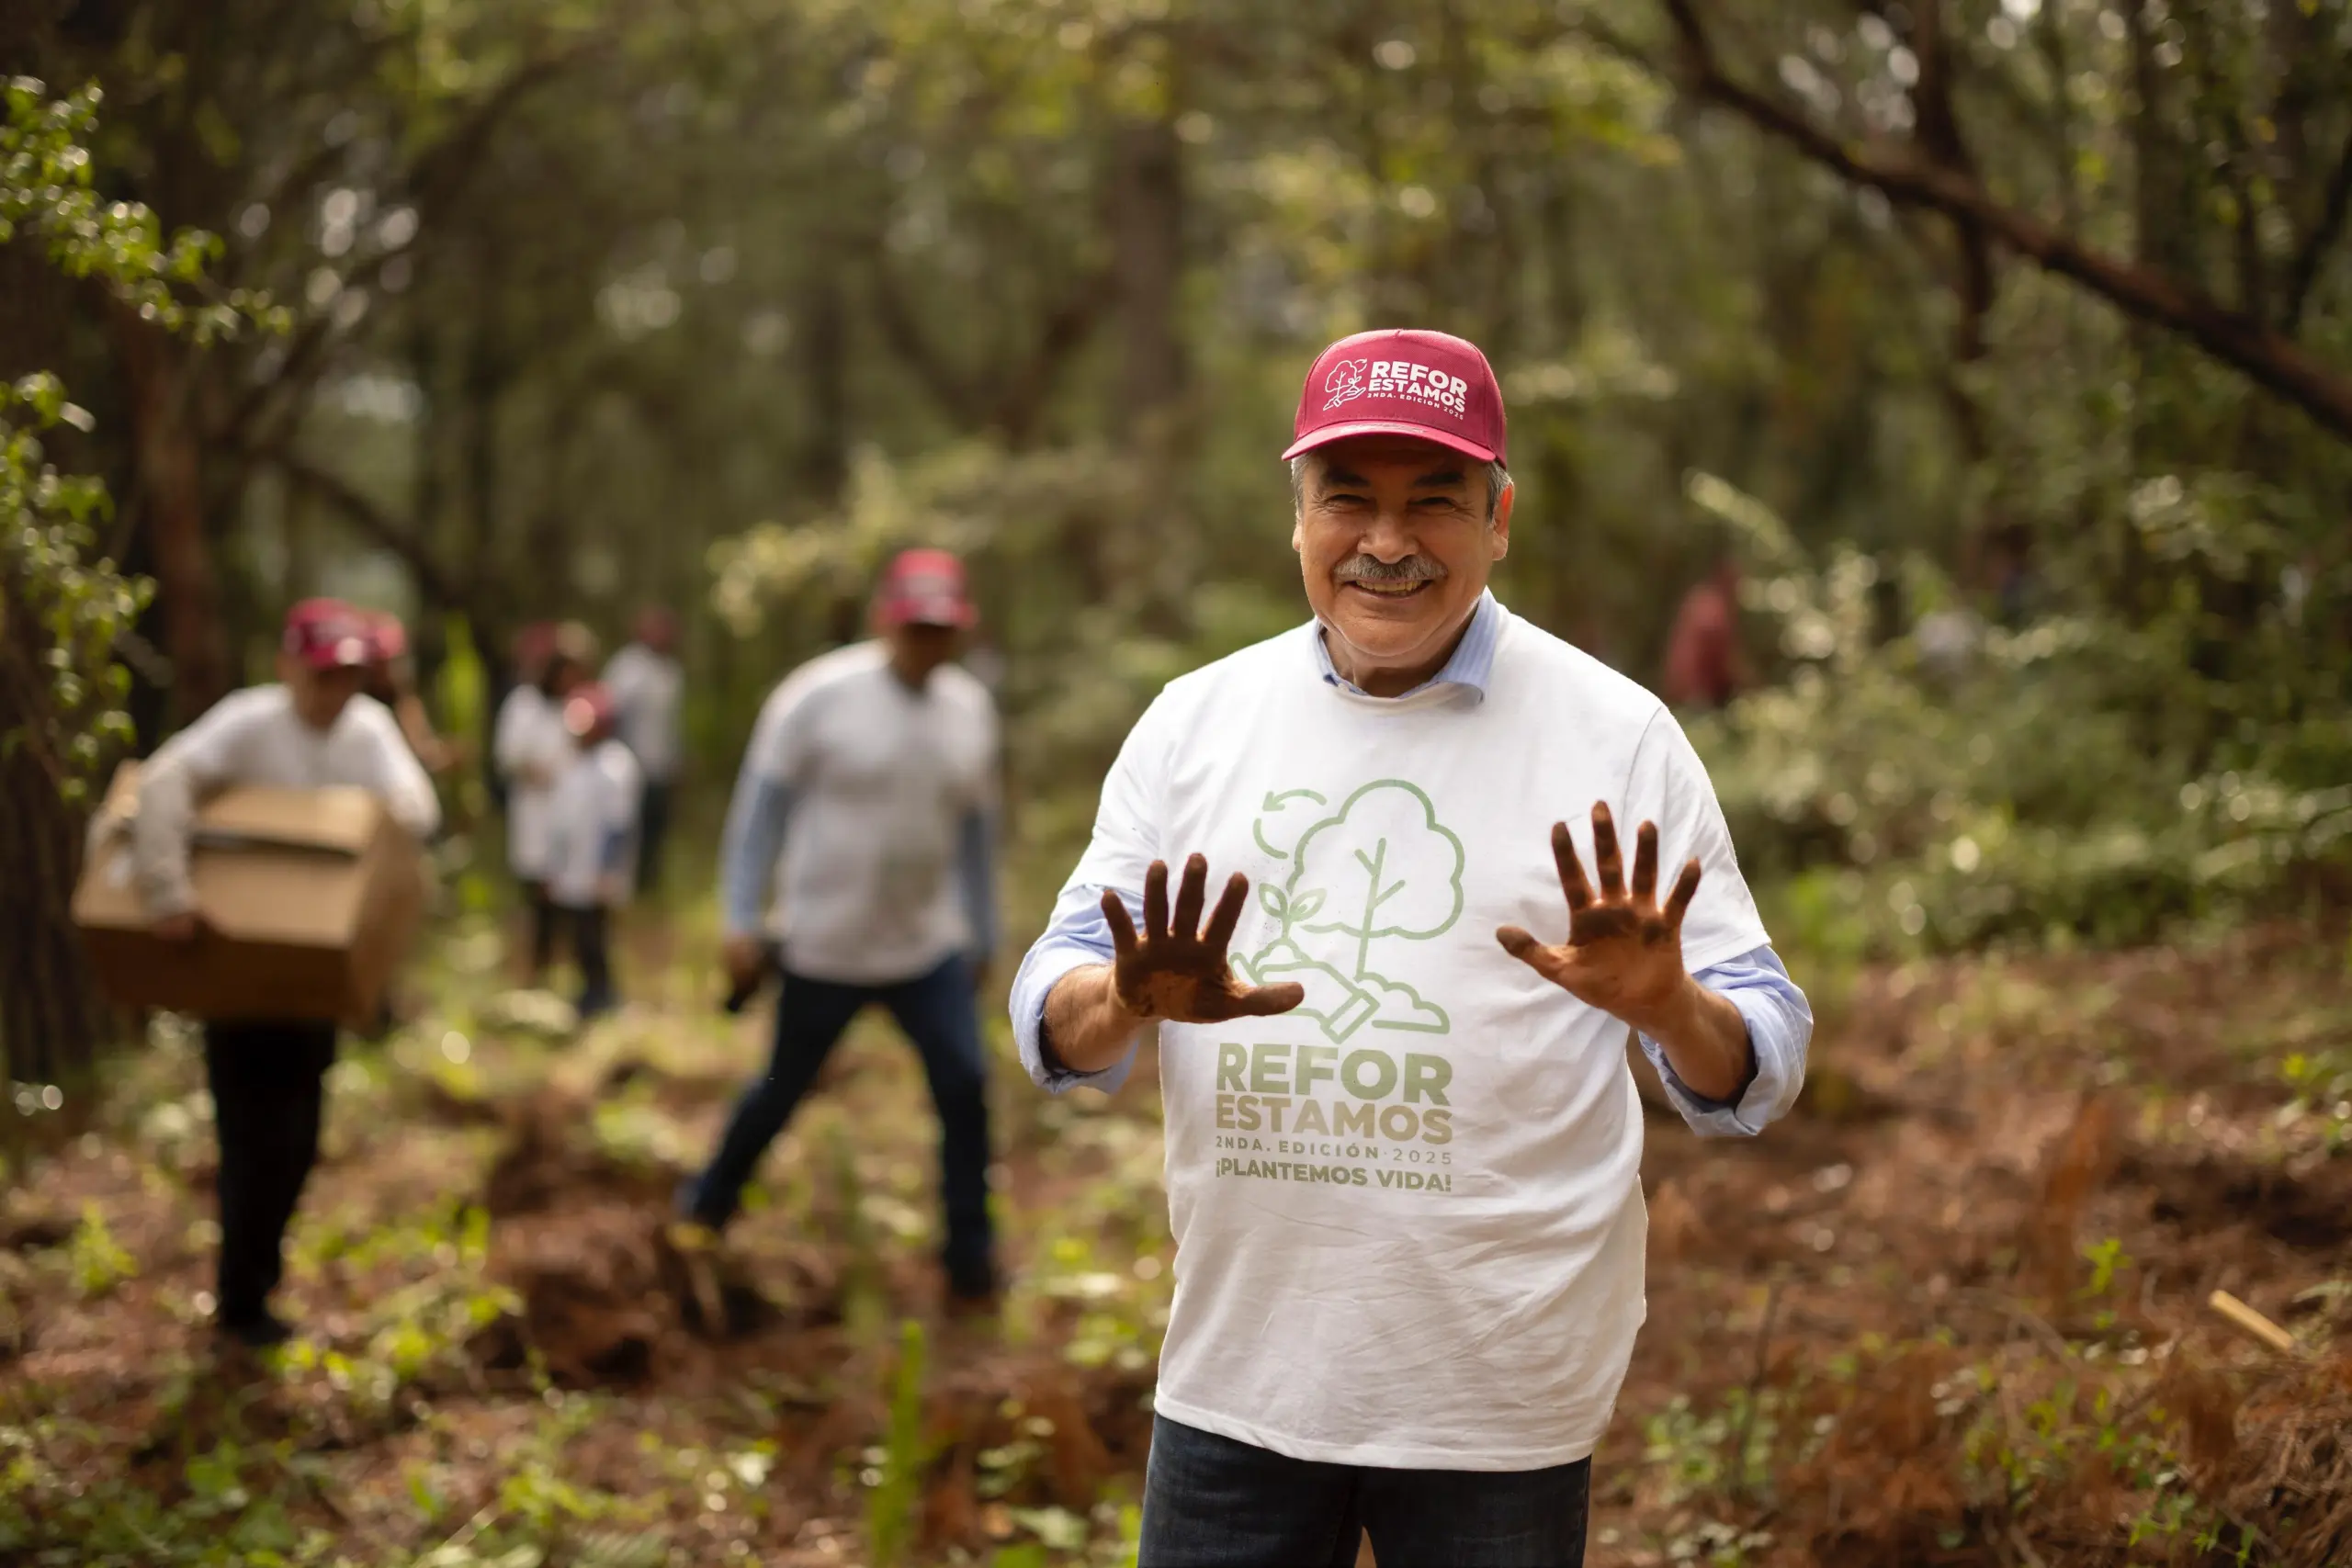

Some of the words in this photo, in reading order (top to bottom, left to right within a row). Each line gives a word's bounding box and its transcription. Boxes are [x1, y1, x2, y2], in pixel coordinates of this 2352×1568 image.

[1368, 378, 1465, 412] ESTAMOS
[1371, 361, 1467, 400] REFOR
[1443, 406, 1464, 421] 2025
[1216, 1043, 1453, 1106] REFOR
[1216, 1094, 1453, 1145] ESTAMOS
[1216, 1135, 1271, 1152] 2NDA.
[1278, 1140, 1378, 1159] EDICIÓN
[1392, 1148, 1452, 1165] 2025
[1216, 1157, 1368, 1186] ¡PLANTEMOS
[1375, 1169, 1452, 1192] VIDA!
